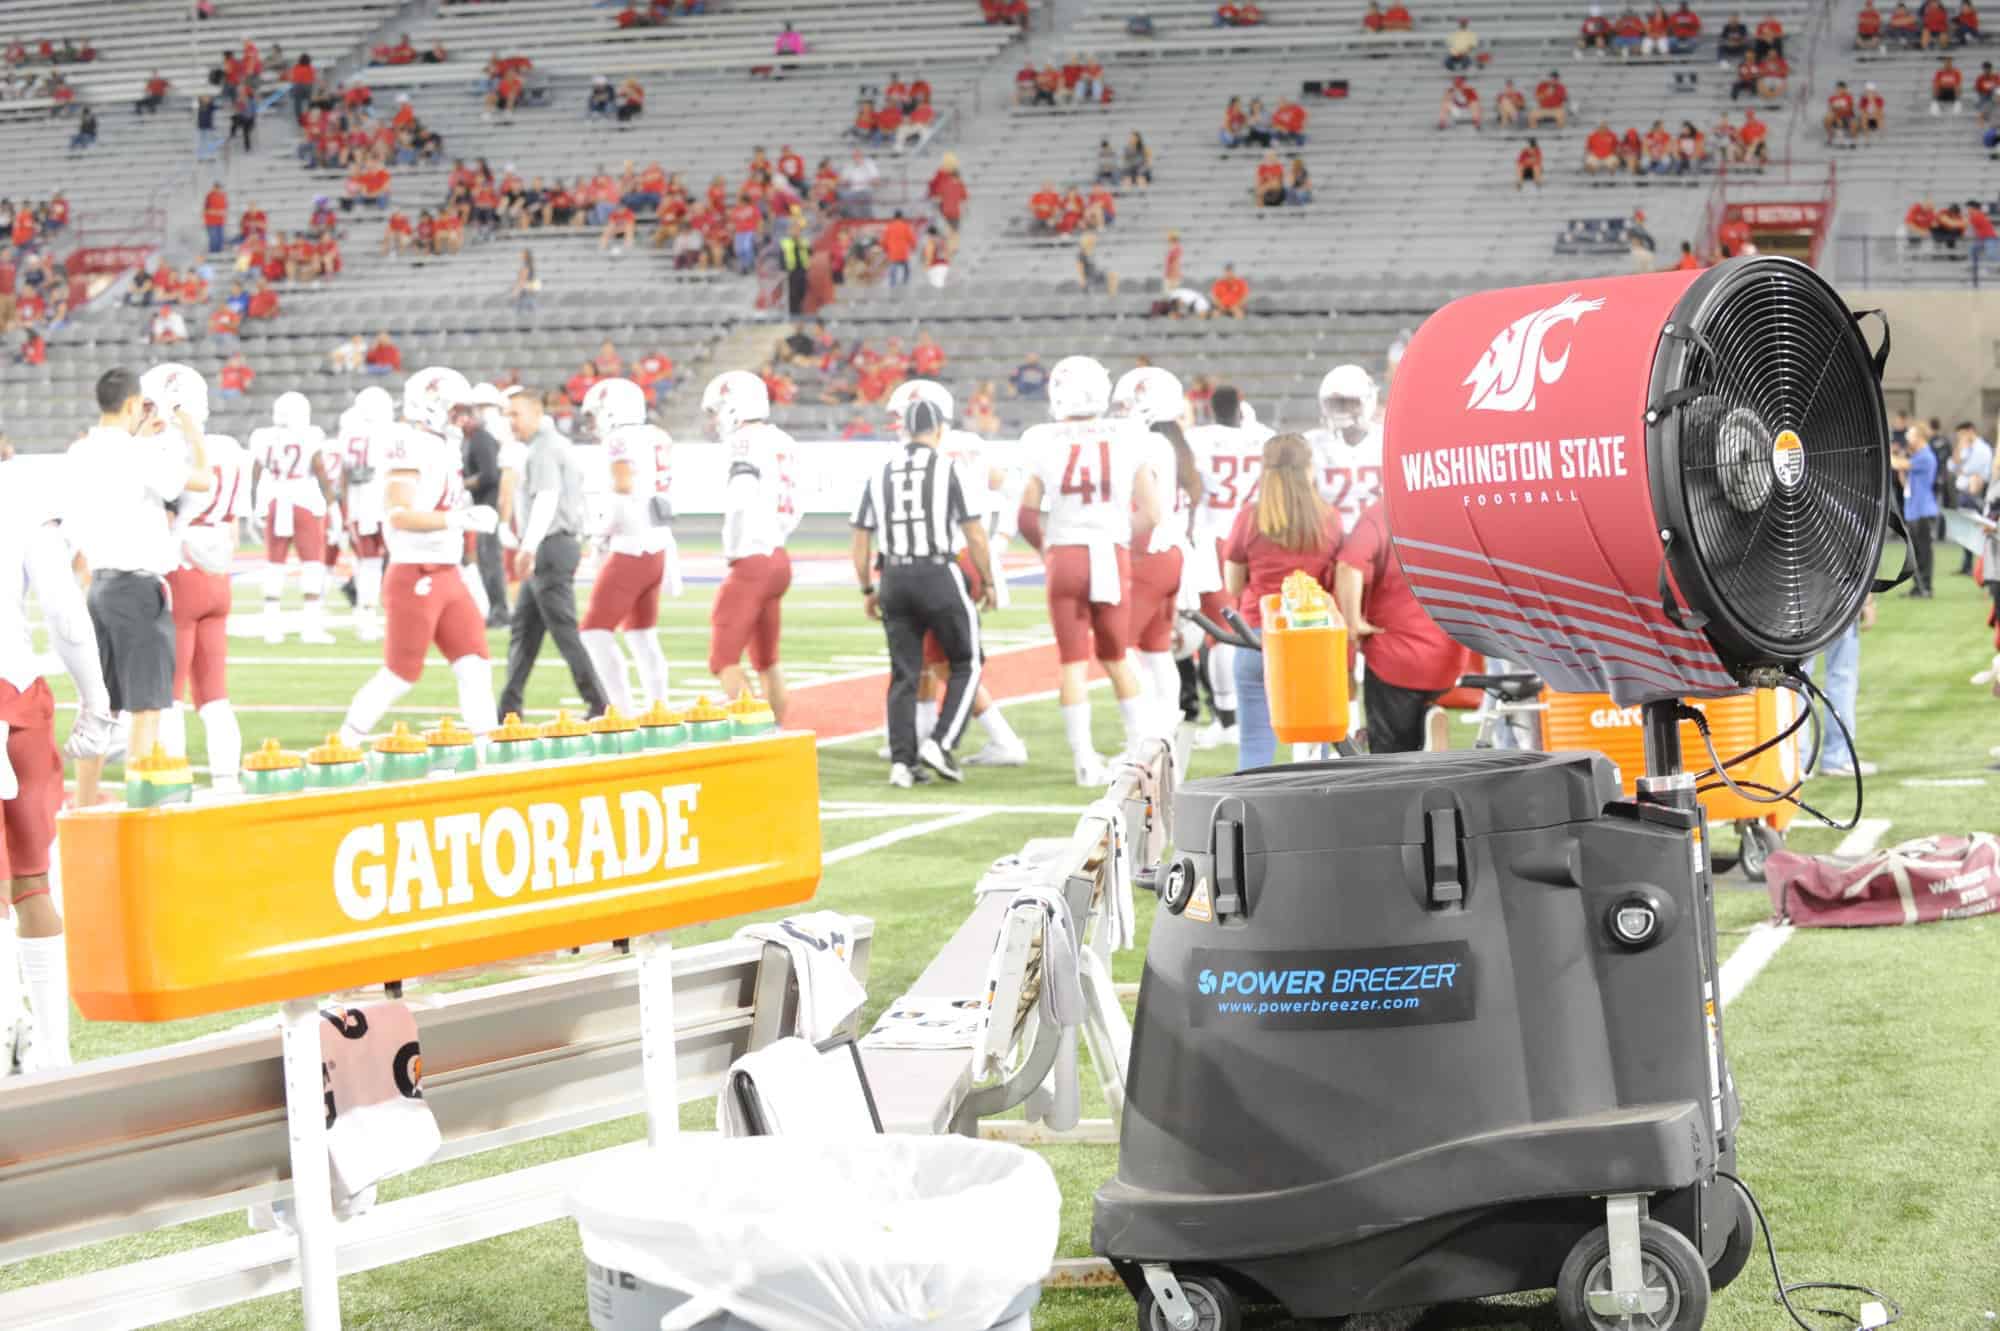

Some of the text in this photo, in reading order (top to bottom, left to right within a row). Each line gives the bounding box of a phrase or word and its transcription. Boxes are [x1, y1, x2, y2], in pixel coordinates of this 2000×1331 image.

[265, 444, 304, 481] 42
[1060, 440, 1112, 505] 41
[1401, 435, 1628, 492] WASHINGTON STATE
[890, 471, 926, 520] H
[1463, 489, 1578, 506] FOOTBALL
[333, 782, 702, 921] GATORADE
[1221, 963, 1457, 995] POWER BREEZER
[1218, 996, 1420, 1015] www.powerbreezer.com
